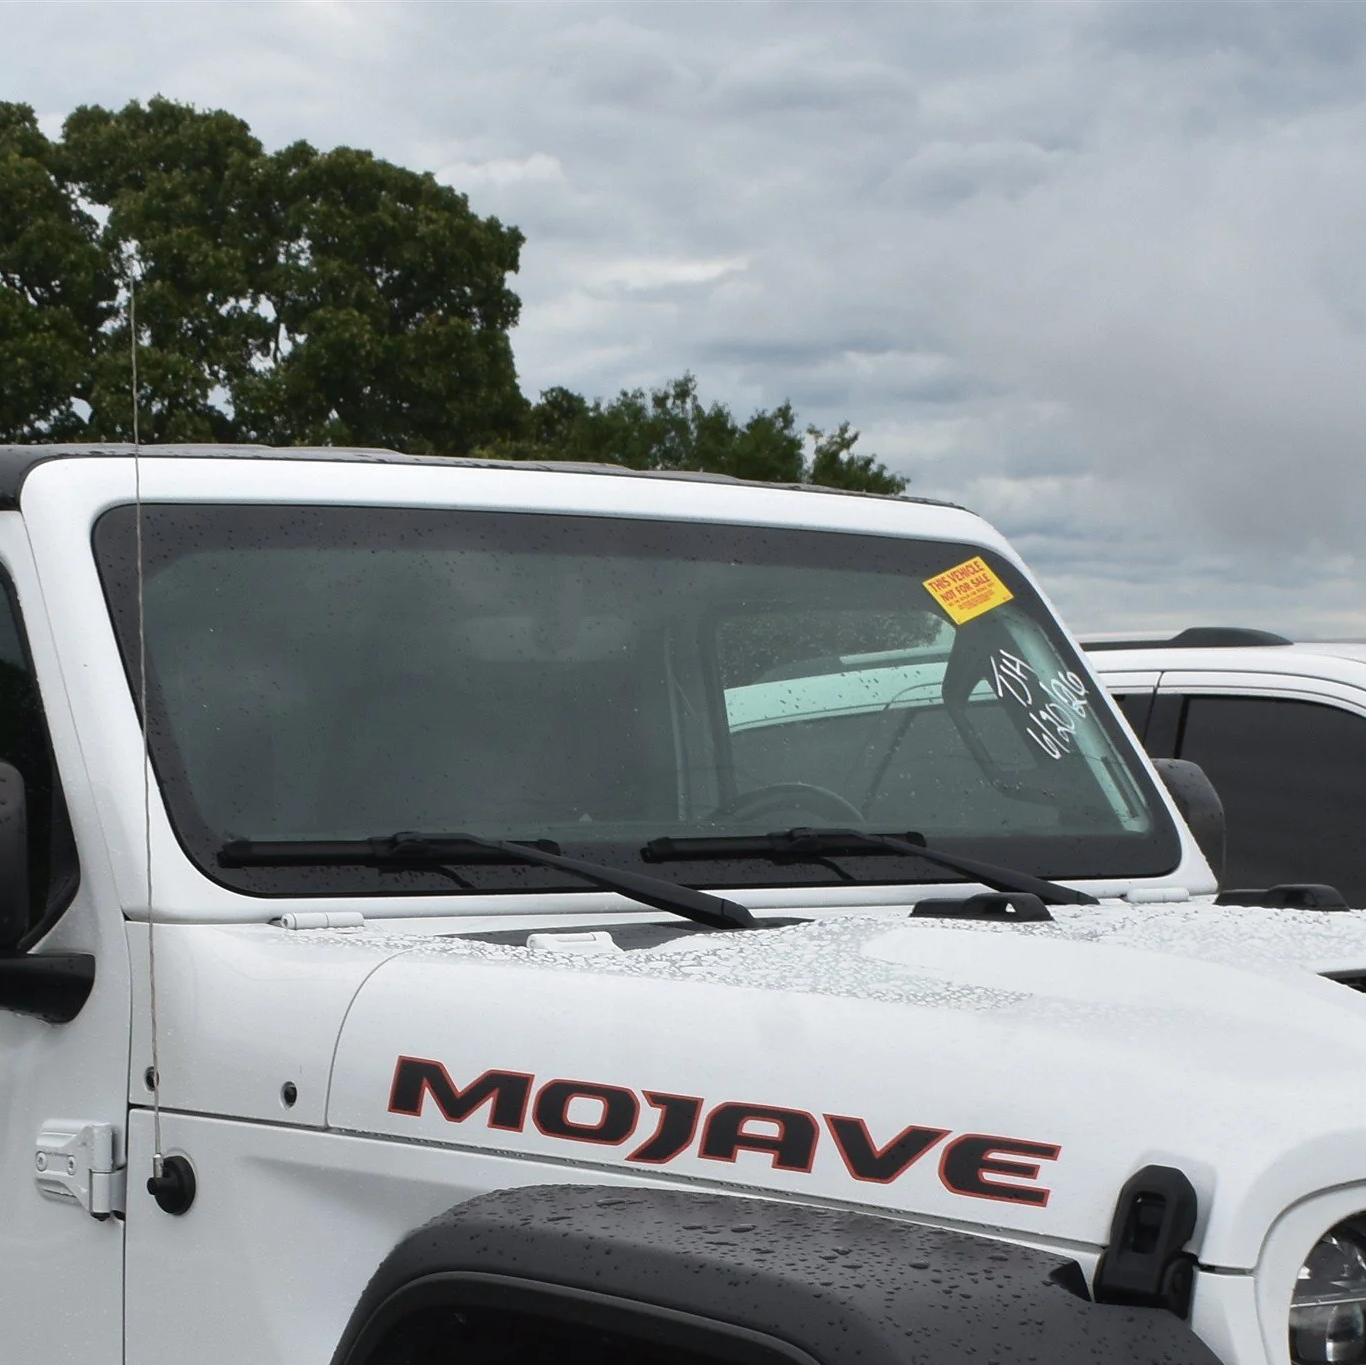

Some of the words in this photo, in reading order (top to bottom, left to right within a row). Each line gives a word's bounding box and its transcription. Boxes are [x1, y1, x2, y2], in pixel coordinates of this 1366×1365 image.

[928, 576, 951, 593] THIS
[946, 560, 984, 584] VEHICLE
[940, 589, 957, 603] NOT
[955, 581, 971, 595] FOR
[970, 573, 991, 588] SALE
[388, 1055, 1062, 1207] MOJAVE
